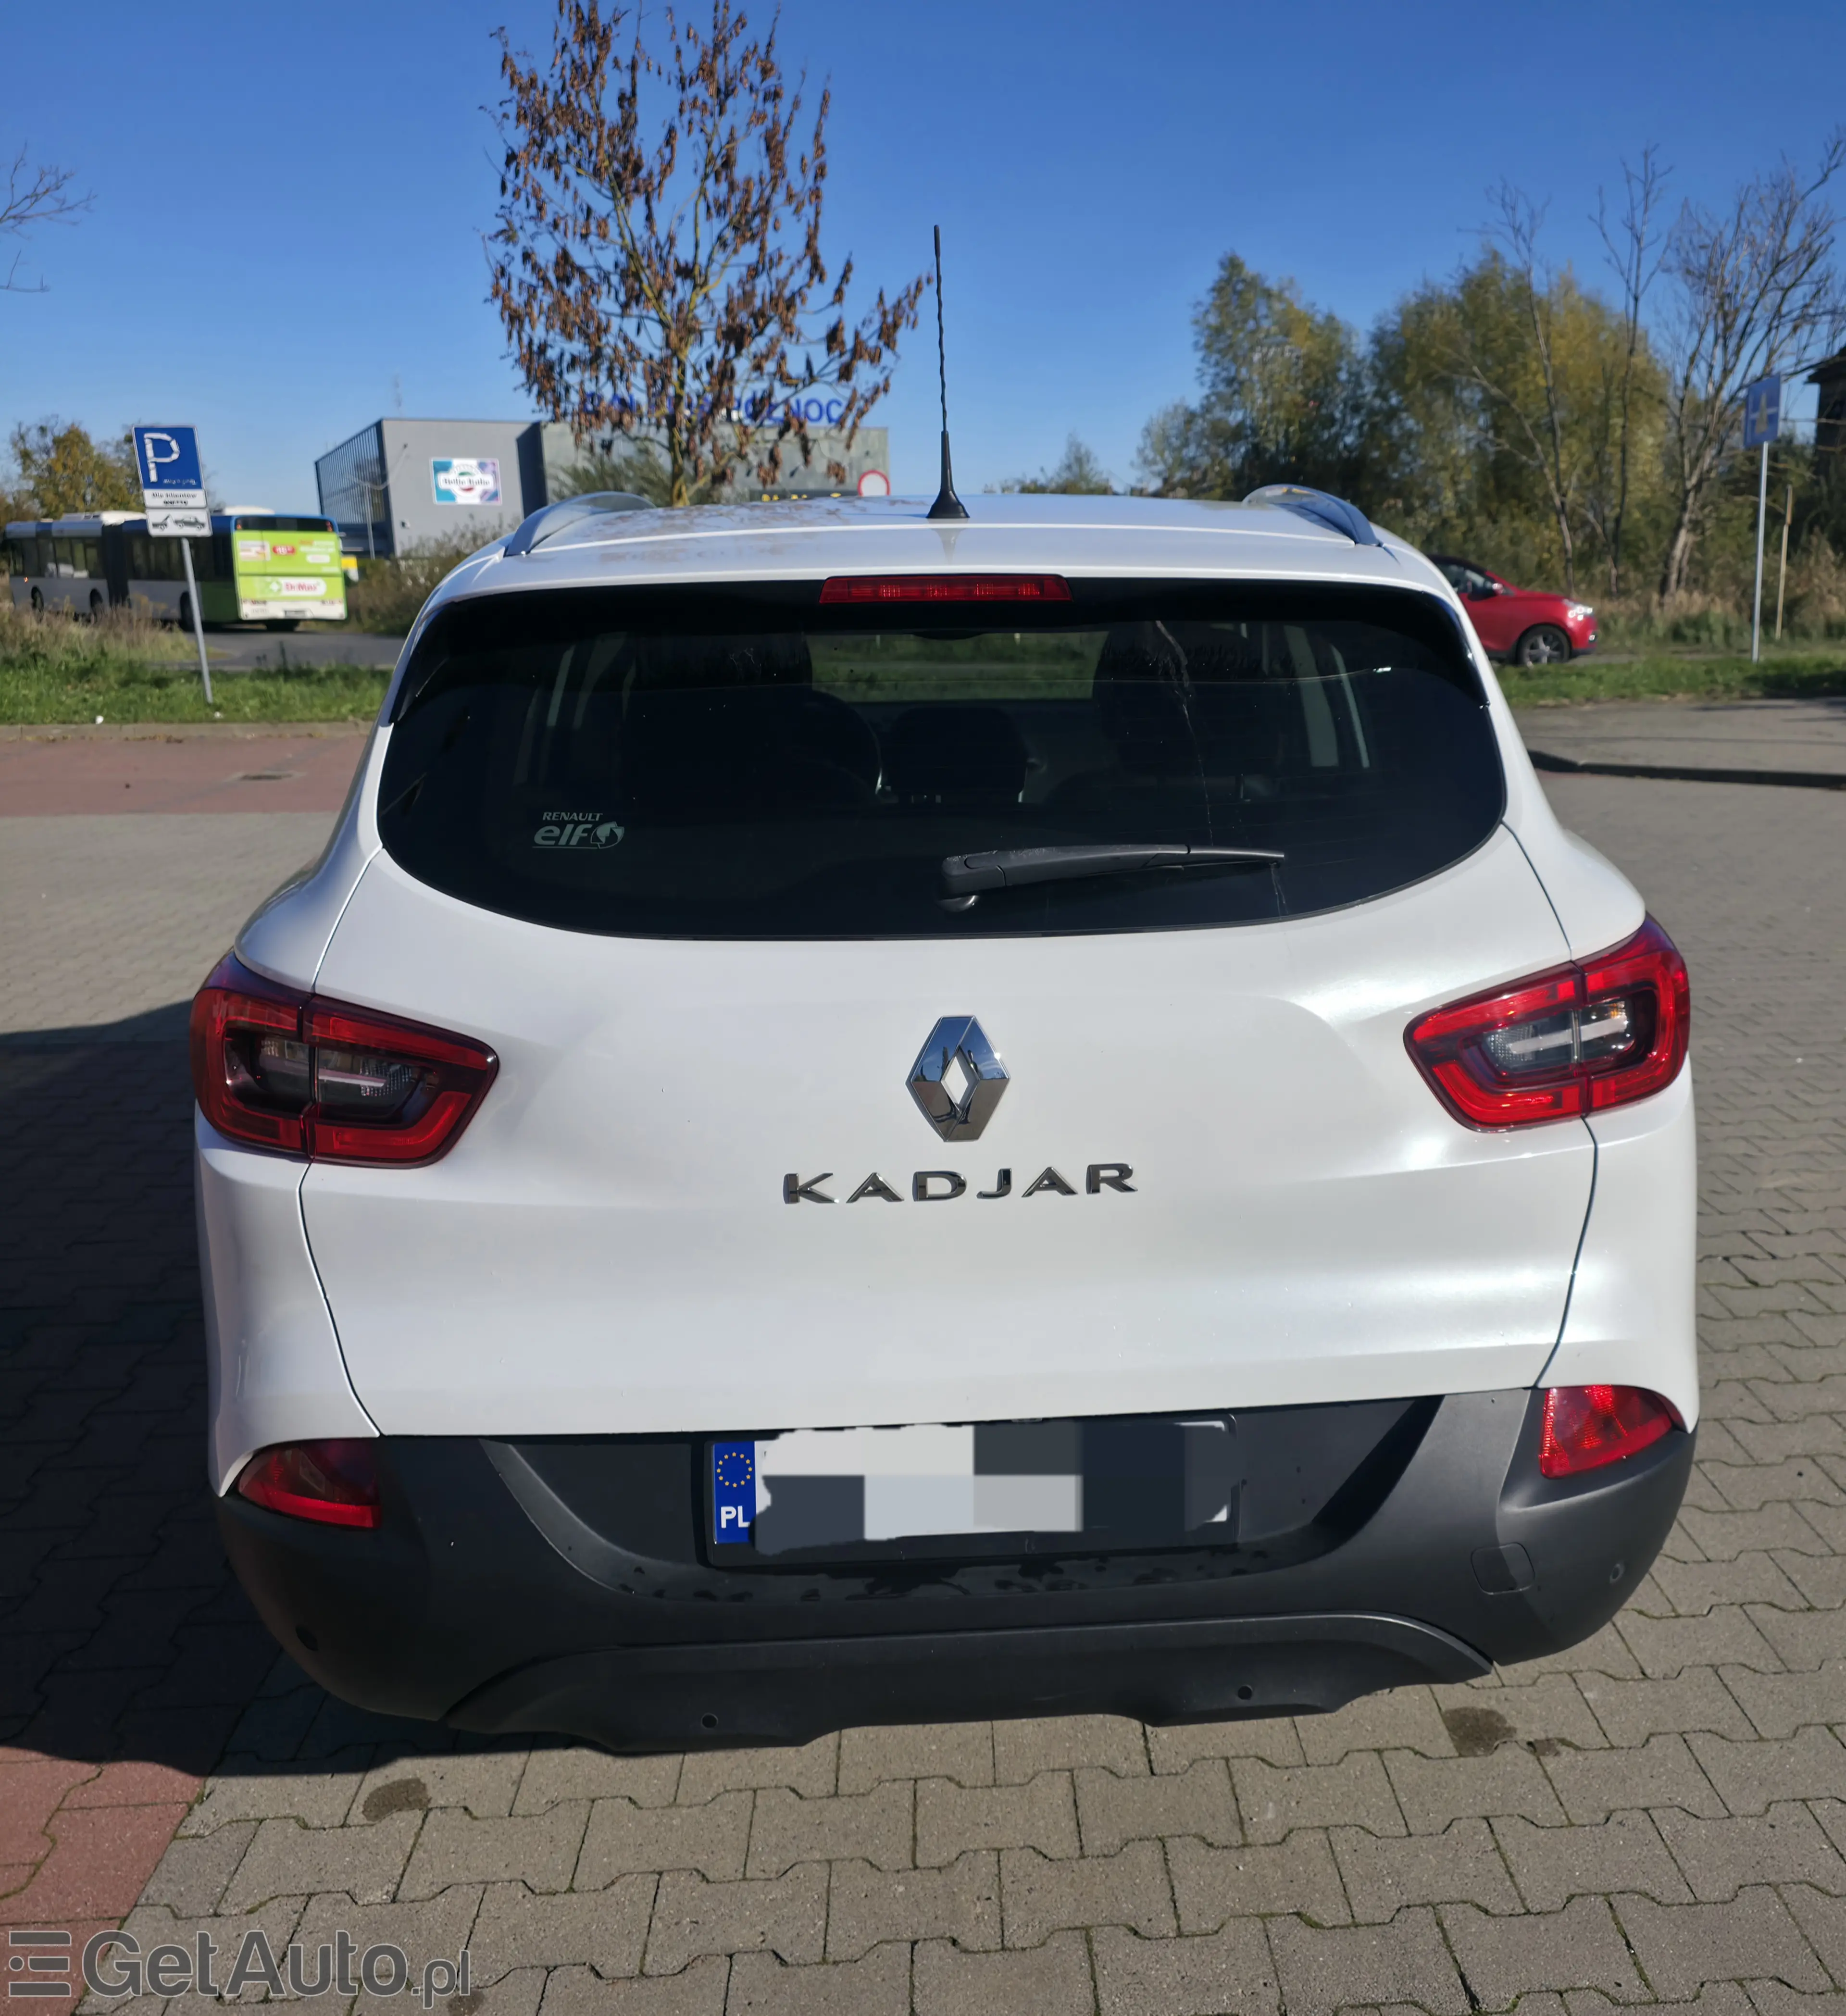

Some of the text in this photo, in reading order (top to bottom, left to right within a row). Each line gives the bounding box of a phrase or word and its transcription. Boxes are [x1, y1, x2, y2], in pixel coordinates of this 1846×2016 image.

[144, 433, 180, 483] P
[542, 811, 603, 821] RENAULT
[534, 823, 593, 846] elf
[783, 1163, 1138, 1204] KADJAR
[721, 1506, 750, 1528] PL
